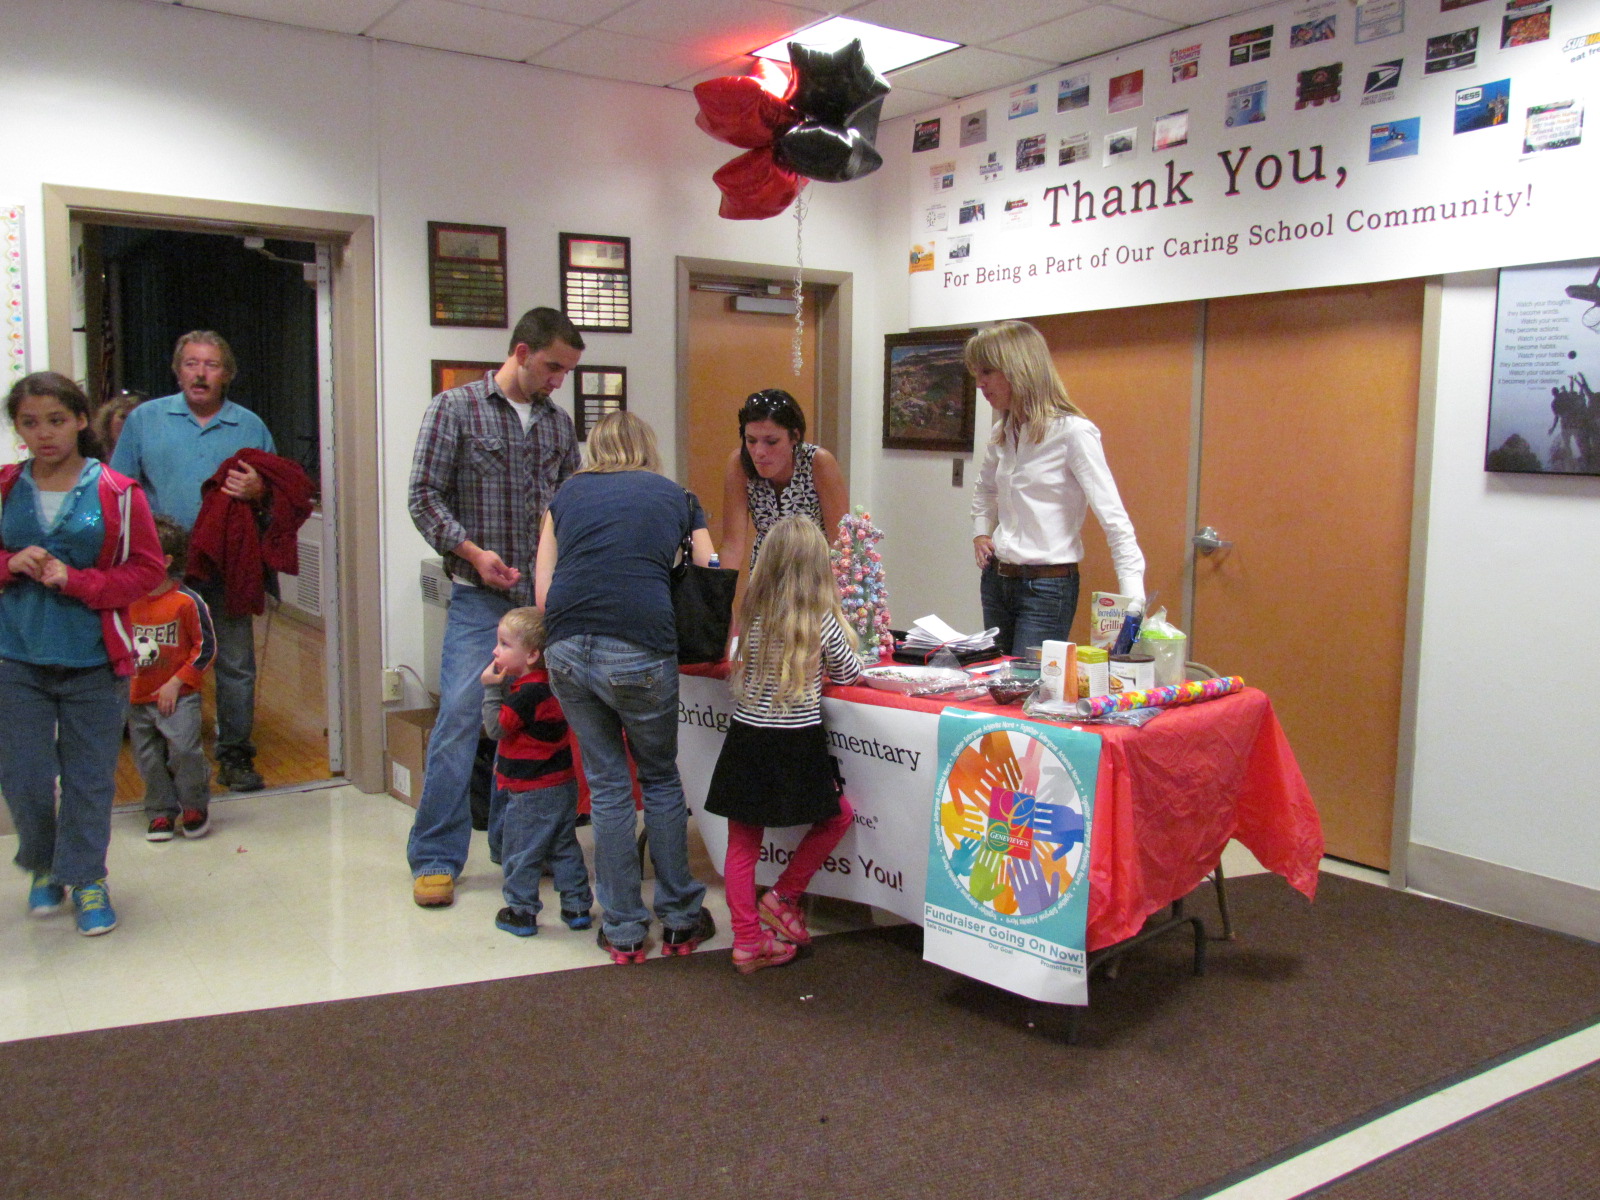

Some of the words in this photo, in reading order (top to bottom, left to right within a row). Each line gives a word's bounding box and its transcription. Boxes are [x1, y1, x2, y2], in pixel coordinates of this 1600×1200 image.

[1457, 90, 1481, 102] HESS
[1043, 160, 1194, 227] Thank
[1217, 145, 1347, 197] You,
[943, 271, 970, 289] For
[976, 264, 1021, 284] Being
[1028, 262, 1038, 276] a
[1045, 254, 1082, 275] Part
[1090, 248, 1110, 268] of
[1116, 245, 1154, 264] Our
[1164, 232, 1240, 258] Caring
[1249, 213, 1334, 246] School
[1346, 184, 1533, 233] Community!
[678, 700, 730, 733] Bridg
[827, 729, 921, 771] mentary
[990, 831, 1029, 847] GENEVIEVE'S
[858, 855, 903, 892] You!
[925, 905, 985, 934] Fundraiser
[989, 926, 1025, 948] Going
[1029, 938, 1046, 954] On
[1049, 945, 1084, 963] Now!
[988, 942, 999, 951] Our
[1000, 945, 1014, 955] Goal
[1040, 960, 1072, 972] Promoted
